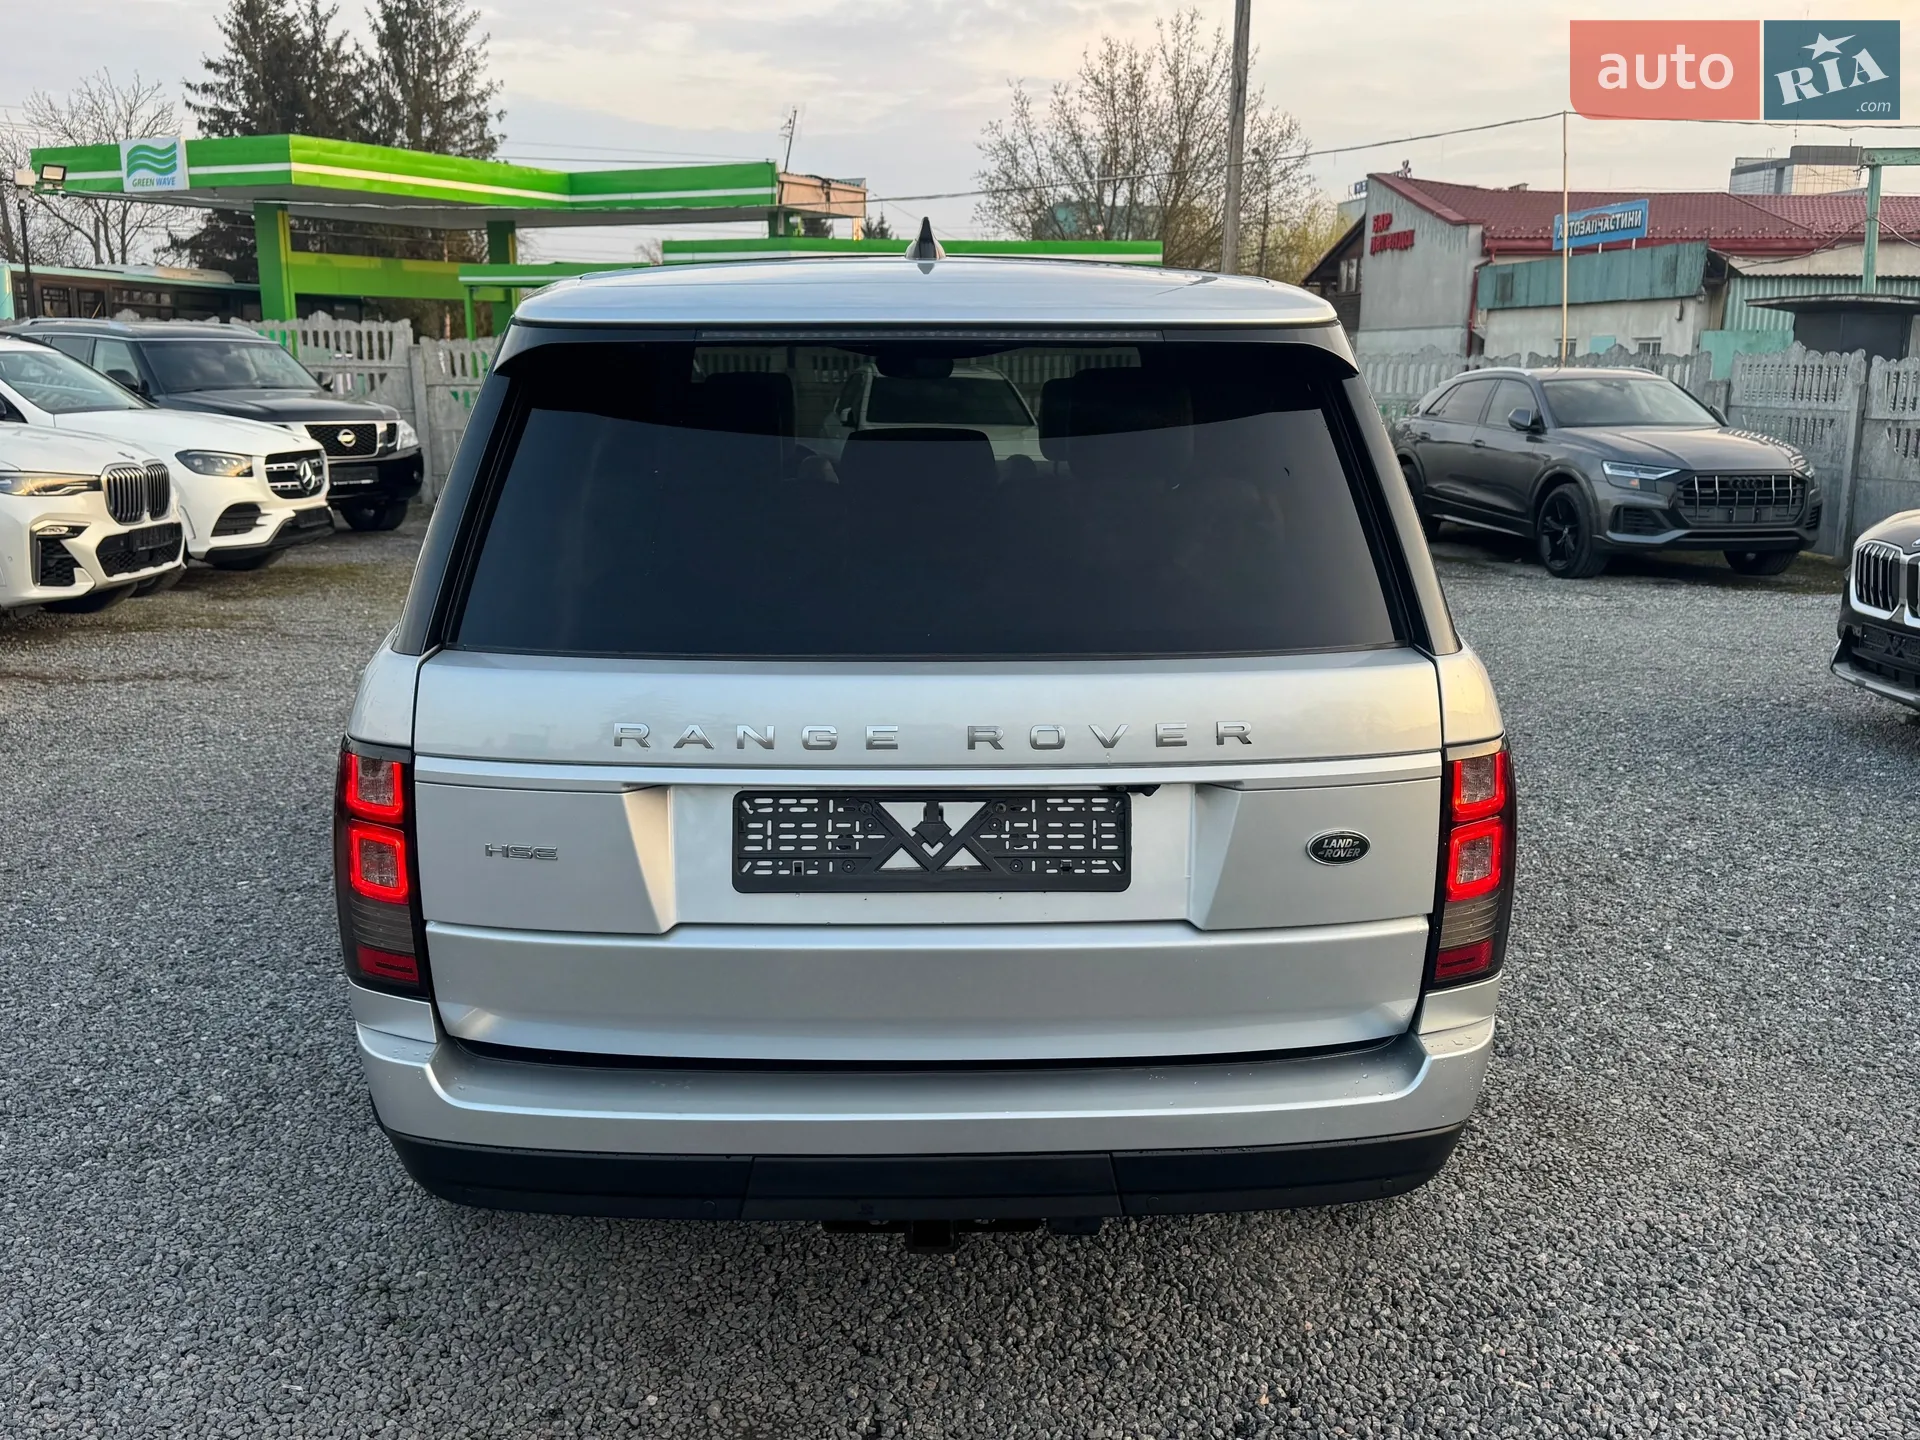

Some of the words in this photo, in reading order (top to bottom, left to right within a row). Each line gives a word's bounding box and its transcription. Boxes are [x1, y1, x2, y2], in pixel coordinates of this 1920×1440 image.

[132, 178, 155, 187] GREEN
[156, 176, 176, 186] WAVE
[1373, 213, 1392, 233] БАР
[613, 722, 899, 751] RANGE
[967, 721, 1253, 751] ROVER
[1323, 838, 1352, 848] LAND
[484, 842, 558, 861] HSE
[1324, 848, 1360, 858] ROVER
